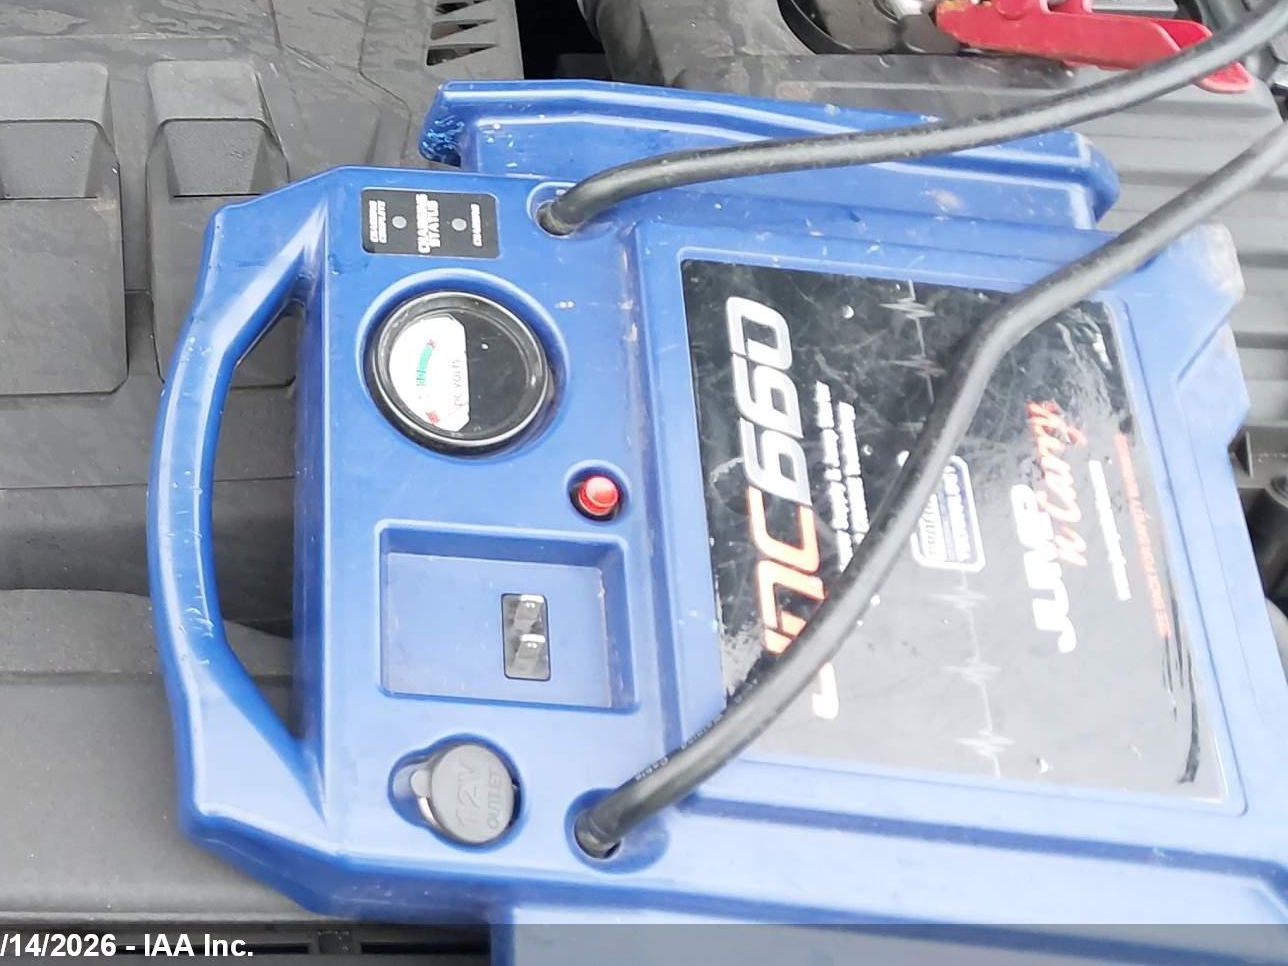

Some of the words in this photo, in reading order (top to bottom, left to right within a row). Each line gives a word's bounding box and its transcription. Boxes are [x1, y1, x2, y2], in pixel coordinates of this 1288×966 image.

[415, 193, 431, 254] CHARGING
[427, 200, 441, 248] STATUS
[1025, 397, 1088, 523] Carry
[1011, 484, 1076, 653] JUMP
[455, 754, 481, 828] 12V
[487, 765, 503, 830] OUTLET
